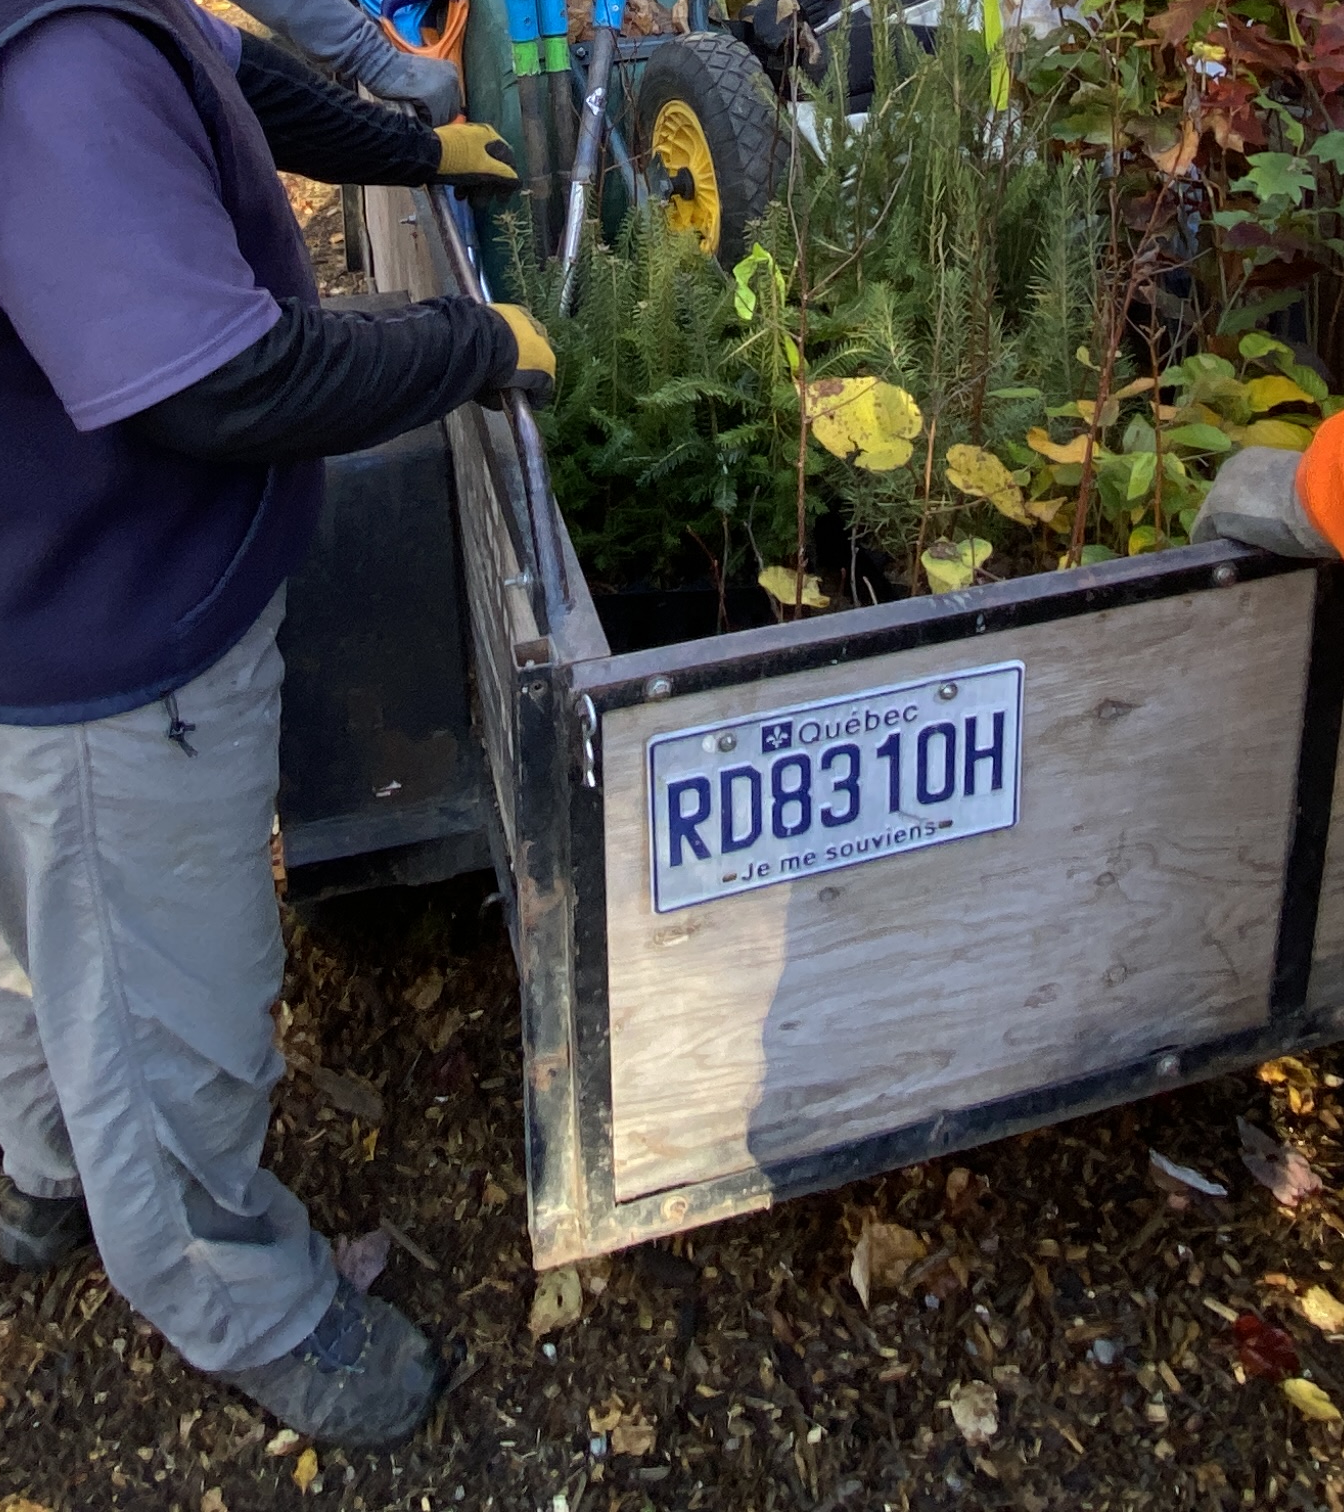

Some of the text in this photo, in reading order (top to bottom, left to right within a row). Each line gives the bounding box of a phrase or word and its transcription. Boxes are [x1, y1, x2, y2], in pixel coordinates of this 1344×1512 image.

[798, 703, 919, 744] Québec
[666, 710, 1006, 868] RD8310H
[741, 821, 938, 882] Je me souviens
